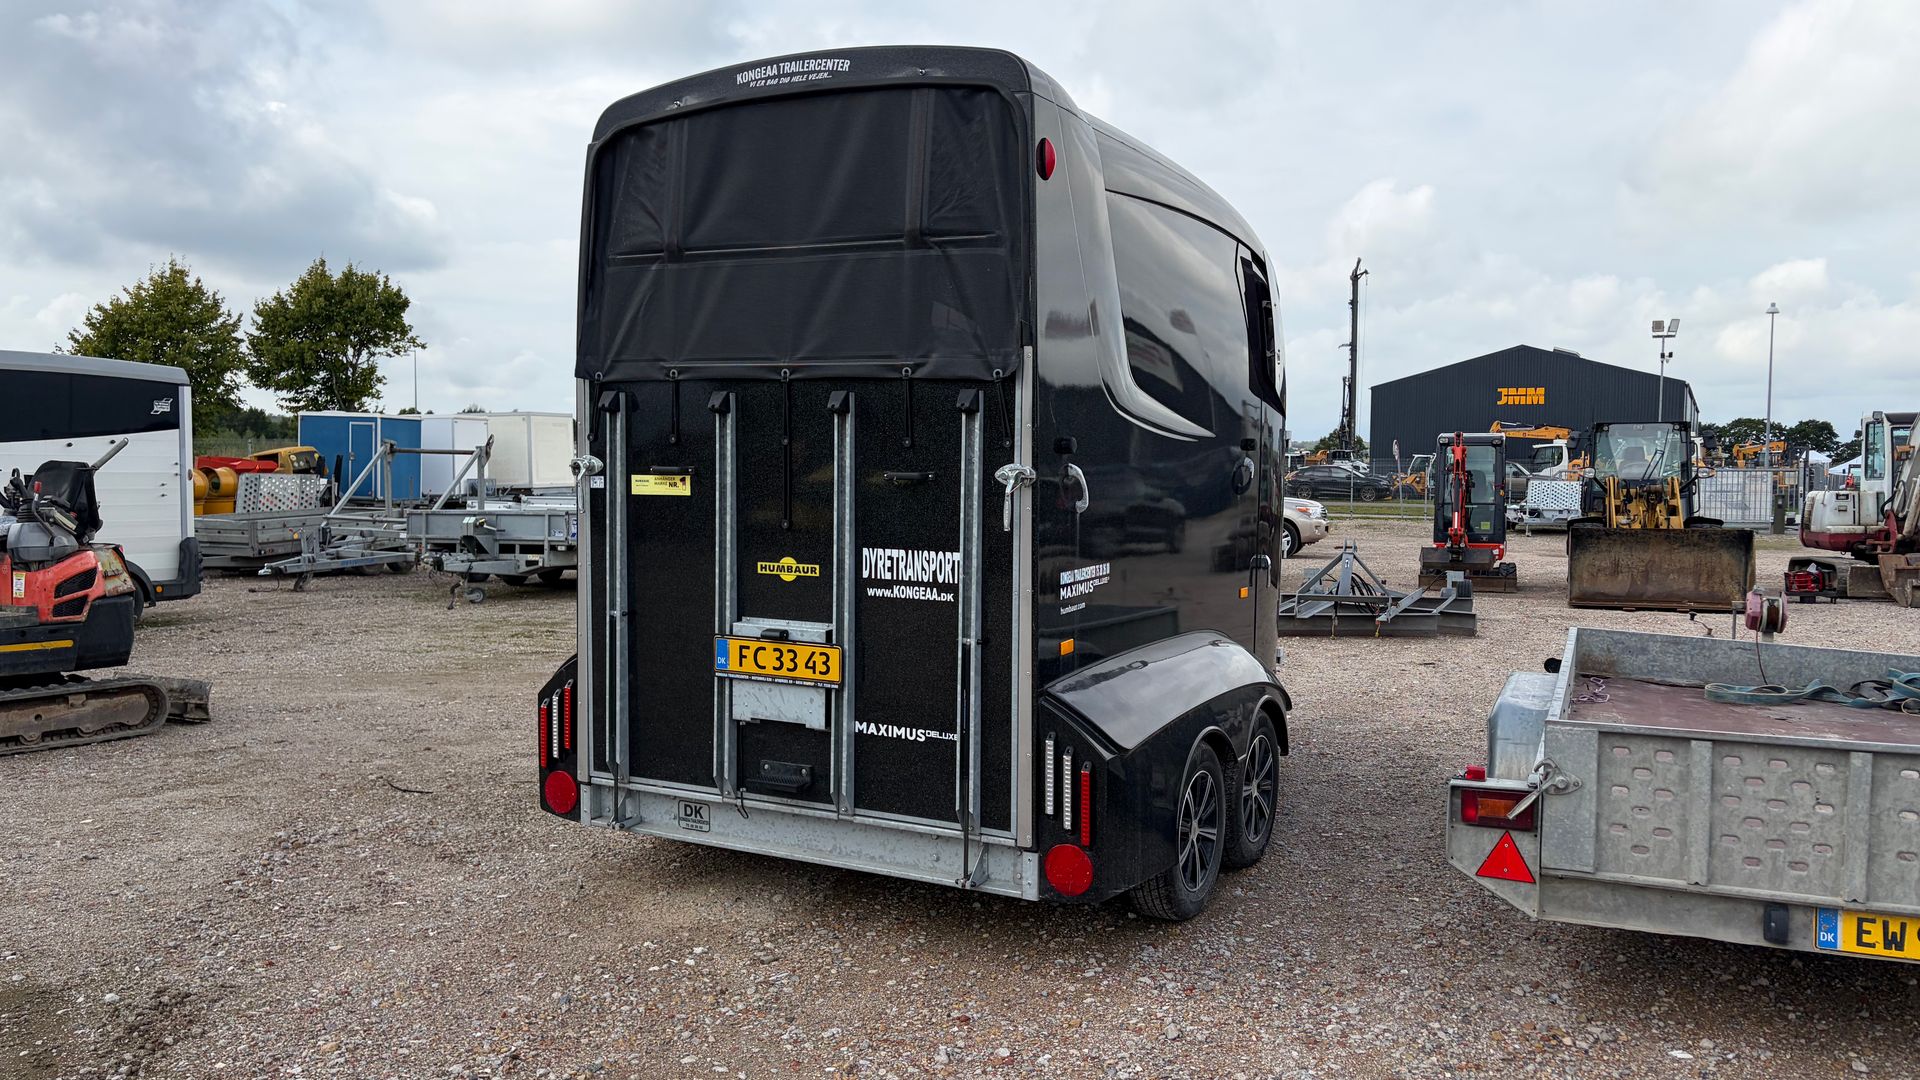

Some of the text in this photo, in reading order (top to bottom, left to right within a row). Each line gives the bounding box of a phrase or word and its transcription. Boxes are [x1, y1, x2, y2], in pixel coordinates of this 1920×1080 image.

[736, 59, 850, 85] KONGEAA TRAILERCENTER
[749, 80, 756, 88] VI
[756, 79, 765, 87] ER
[790, 75, 807, 83] HELE
[1497, 387, 1545, 405] JMM
[760, 563, 818, 575] HUMBAUR
[862, 547, 961, 584] DYRETRANSPORT
[866, 585, 955, 602] www.KONGEAA.DK
[1060, 580, 1094, 600] MAXIMUS
[717, 645, 831, 675] DK FC 33 43
[854, 720, 926, 742] MAXIMUS
[684, 803, 704, 819] DK
[1820, 931, 1835, 943] DK
[1856, 916, 1907, 952] EW
